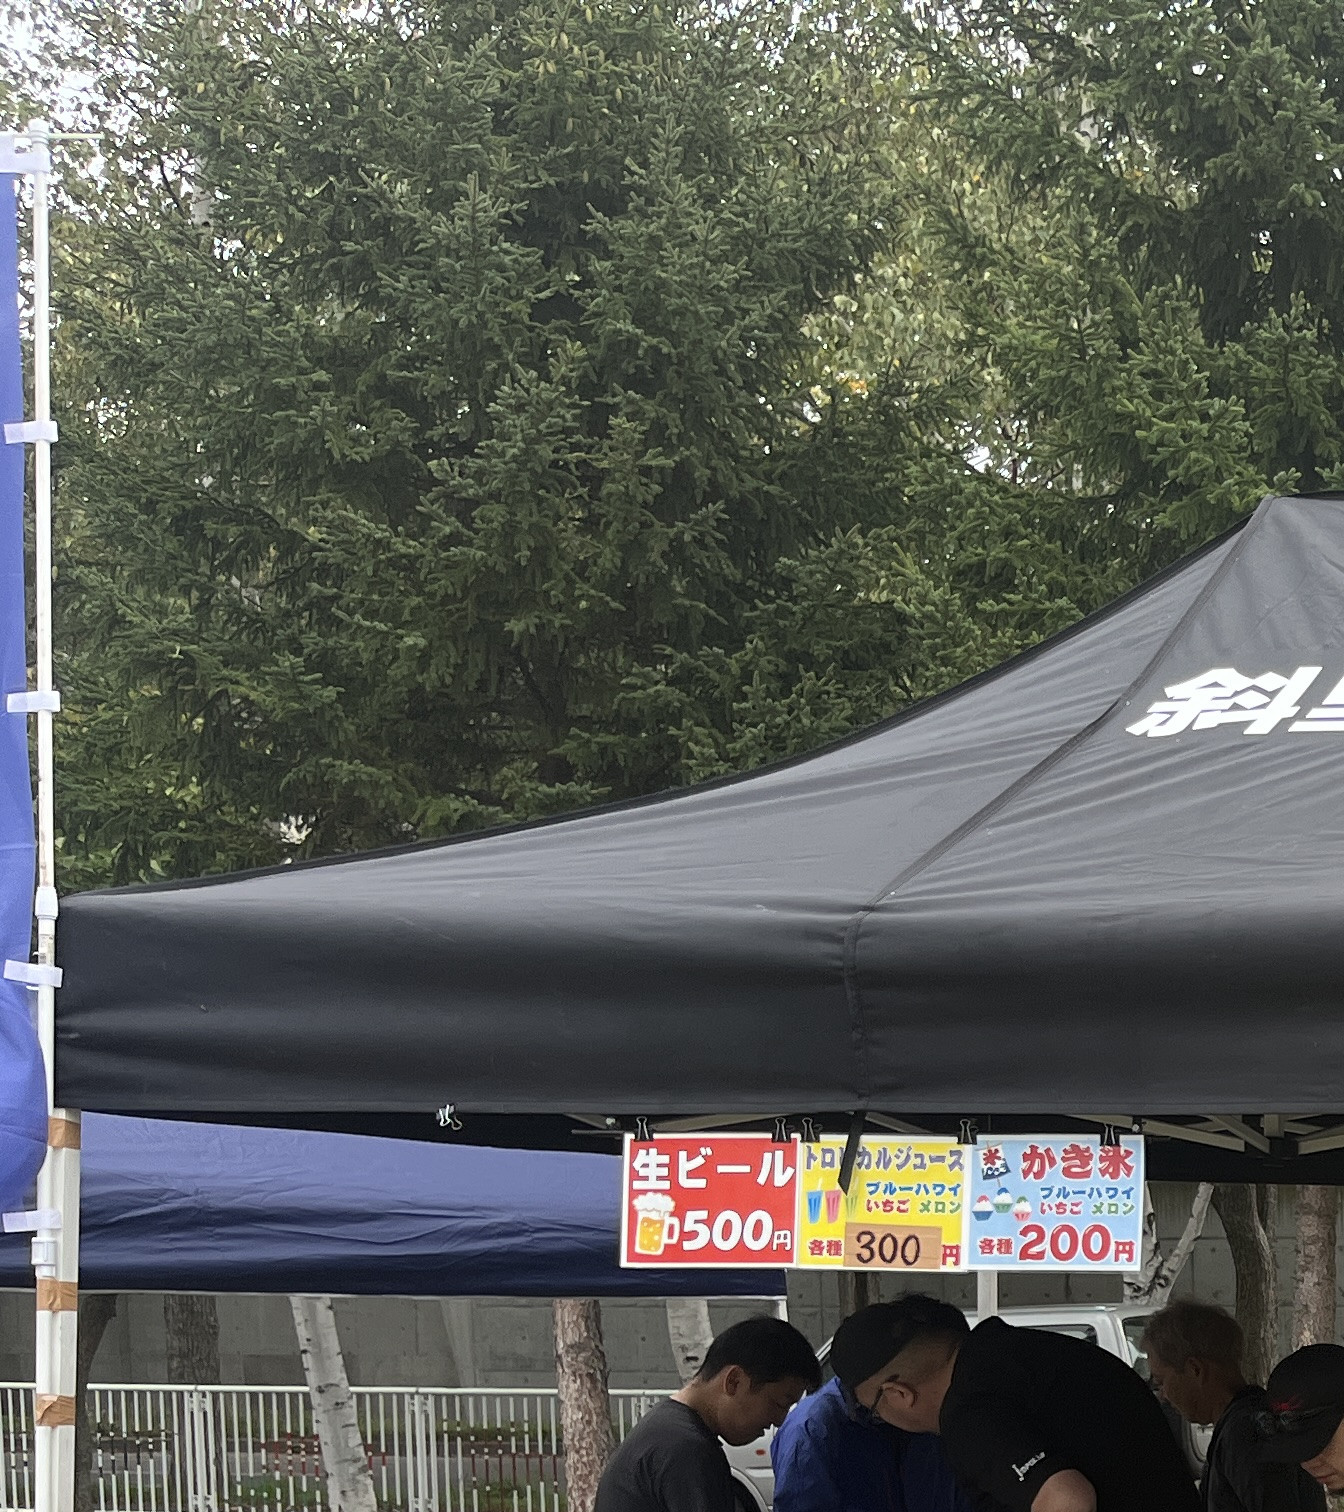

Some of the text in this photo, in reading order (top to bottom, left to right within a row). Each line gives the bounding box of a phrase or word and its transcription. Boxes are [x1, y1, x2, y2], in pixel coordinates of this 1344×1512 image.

[632, 1147, 795, 1191] 生ビール
[1021, 1143, 1134, 1180] かき氷
[866, 1182, 961, 1196] ブルーハワイ
[1040, 1186, 1134, 1199] ブルーハワイ
[866, 1199, 960, 1214] いちご メロン
[1040, 1201, 1134, 1215] いちご メロン
[682, 1210, 791, 1252] 500円
[809, 1239, 842, 1256] 各種
[979, 1224, 1135, 1262] 各種 200円
